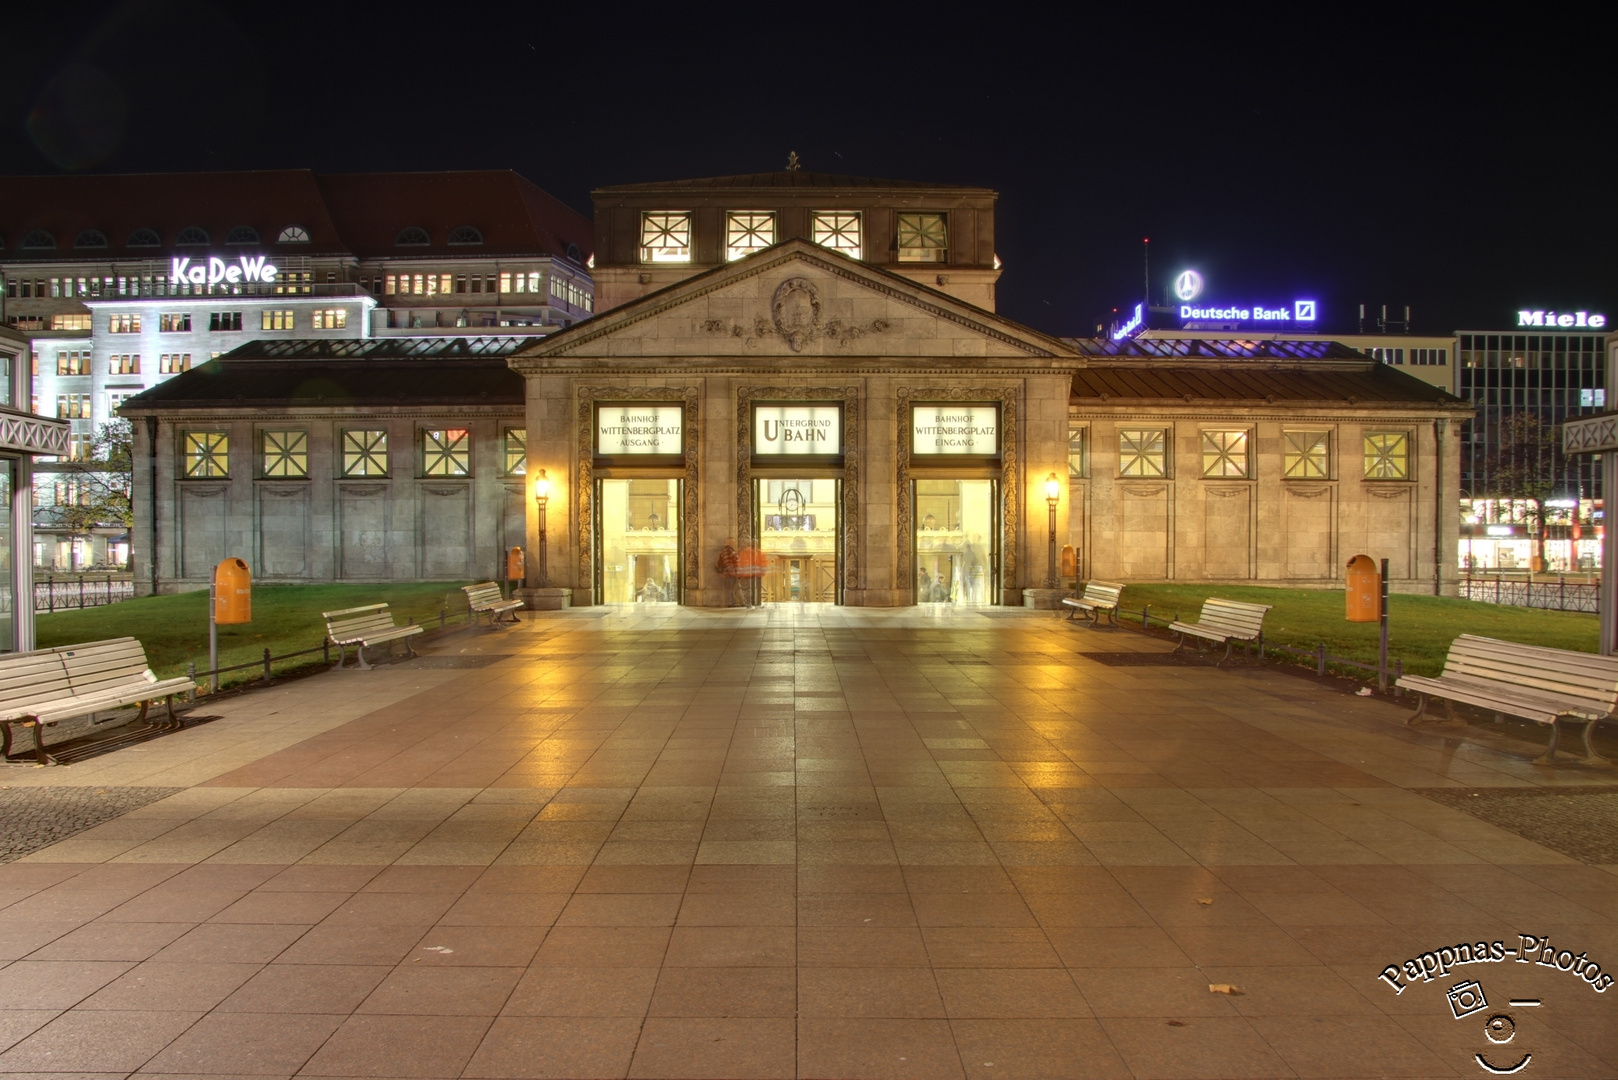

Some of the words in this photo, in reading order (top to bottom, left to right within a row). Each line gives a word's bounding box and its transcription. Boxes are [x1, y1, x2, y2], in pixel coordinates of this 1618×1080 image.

[171, 256, 278, 284] KaDeWe
[1180, 305, 1249, 320] Deutsche
[1253, 307, 1290, 321] Bank
[1517, 310, 1606, 328] Miele
[620, 415, 660, 423] BAHNHOF
[935, 415, 975, 423] BAHNHOF
[600, 426, 681, 435] WITTENBERGPLATZ
[784, 428, 827, 442] BAHN
[915, 426, 995, 435] WITTENBERGPLATZ
[619, 438, 660, 447] AUSGANG
[935, 438, 975, 447] EINGANG
